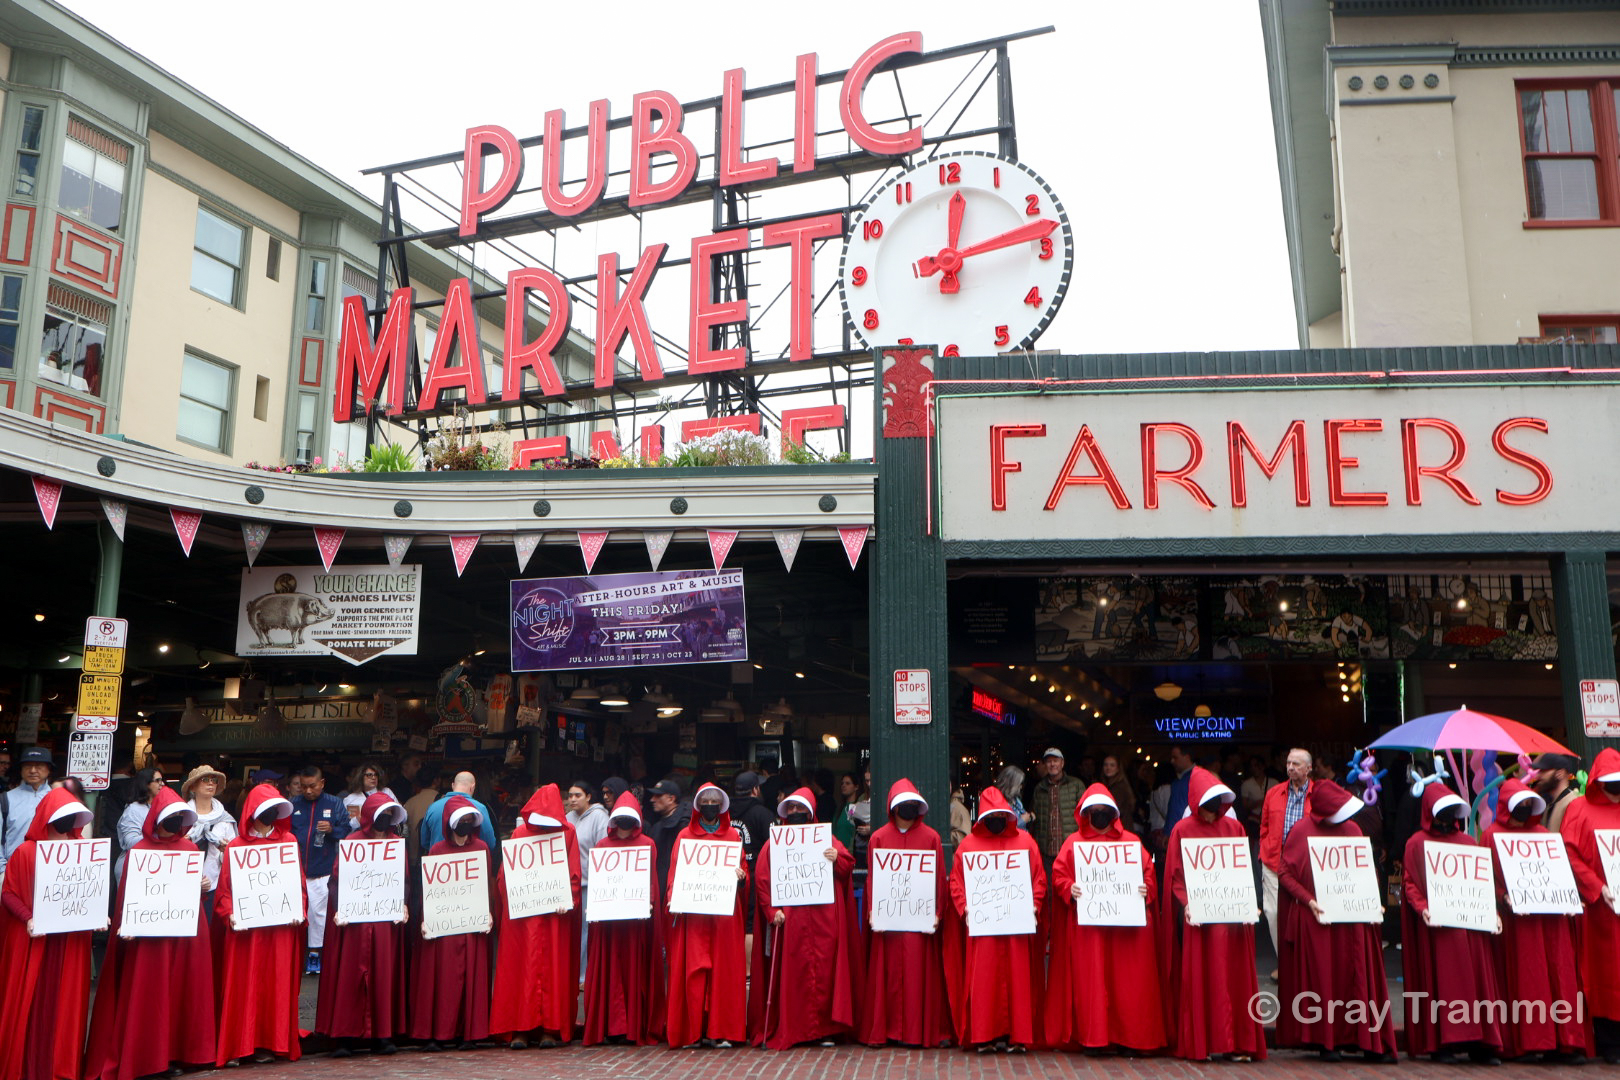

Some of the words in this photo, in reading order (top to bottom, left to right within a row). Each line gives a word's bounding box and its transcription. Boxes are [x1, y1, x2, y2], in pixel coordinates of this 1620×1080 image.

[459, 31, 925, 237] PUBLIC
[939, 162, 961, 184] 12
[994, 167, 1000, 188] 1
[896, 182, 911, 204] 11
[1025, 194, 1040, 215] 2
[864, 219, 883, 241] 10
[1039, 238, 1053, 260] 3
[852, 266, 868, 286] 9
[1024, 286, 1043, 308] 4
[333, 212, 846, 423] MARKET
[864, 308, 879, 330] 8
[994, 325, 1010, 346] 5
[990, 418, 1554, 511] FARMERS
[314, 574, 354, 594] YOUR
[356, 574, 417, 593] CHANGE
[574, 586, 657, 604] AFTER-HOURS
[661, 582, 684, 593] ART
[689, 581, 696, 589] &
[702, 575, 741, 586] MUSIC
[329, 594, 380, 603] CHANGES
[382, 594, 416, 602] LIVES!
[527, 593, 547, 606] The
[514, 599, 574, 628] NIGHT
[591, 607, 622, 618] THIS
[628, 604, 684, 616] FRIDAY!
[529, 618, 570, 642] Shift
[613, 631, 636, 641] 3PM
[645, 629, 668, 639] 9PM
[328, 640, 365, 648] DONATE
[368, 640, 395, 648] HERE!
[900, 683, 926, 692] STOPS
[1582, 683, 1593, 691] NO
[1587, 695, 1615, 703] STOPS
[1155, 717, 1245, 731] VIEWPOINT
[772, 826, 824, 846] VOTE
[40, 842, 108, 864] VOTE
[234, 845, 297, 870] VOTE
[340, 841, 399, 863] VOTE
[503, 836, 565, 871] VOTE
[682, 843, 739, 867] VOTE
[1079, 844, 1138, 865] VOTE
[1185, 844, 1247, 870] VOTE
[1311, 846, 1368, 871] VOTE
[1501, 839, 1560, 859] VOTE
[135, 852, 200, 874] VOTE
[591, 849, 650, 872] VOTE
[875, 852, 935, 873] VOTE
[965, 852, 1021, 871] VOTE
[1427, 850, 1489, 882] VOTE
[1520, 861, 1550, 876] FOR
[56, 863, 105, 882] AGAINST
[248, 870, 282, 890] FOR
[423, 858, 480, 884] VOTE
[525, 870, 540, 882] FOR
[608, 875, 624, 884] FOR
[699, 870, 720, 880] FOR
[778, 862, 828, 882] GENDER
[891, 873, 911, 886] FOR
[1080, 867, 1117, 883] While
[1203, 872, 1220, 884] FOR
[1336, 872, 1351, 882] FOR
[43, 880, 104, 902] ABORTION
[145, 878, 168, 896] For
[426, 884, 474, 900] AGAINST
[510, 879, 565, 898] MATERNAL
[682, 882, 732, 893] IMMIGRANT
[776, 881, 823, 900] EQUITY
[1086, 883, 1108, 900] you
[1430, 880, 1454, 898] YOUR
[1460, 886, 1484, 898] LIFE
[1517, 876, 1559, 889] OUR
[593, 888, 618, 900] YOUR
[624, 888, 648, 898] LIFE
[693, 893, 718, 902] LIVES
[891, 887, 911, 899] OUR
[972, 884, 1026, 906] DEPENDS
[1188, 886, 1255, 900] IMMIGRANT
[62, 900, 89, 917] BANS
[125, 900, 195, 925] Freedom
[340, 902, 371, 919] SEXUAL
[436, 903, 470, 914] SEXUAL
[511, 895, 565, 914] HEALTHCARE
[877, 899, 933, 918] FUTURE
[1087, 901, 1121, 920] CAN.
[1204, 902, 1250, 918] RIGHTS
[1343, 897, 1378, 912] RIGHTS
[1446, 900, 1489, 910] DEPENDS
[426, 914, 489, 933] VIOLENCE
[1456, 913, 1468, 922] ON
[1474, 915, 1486, 924] IT
